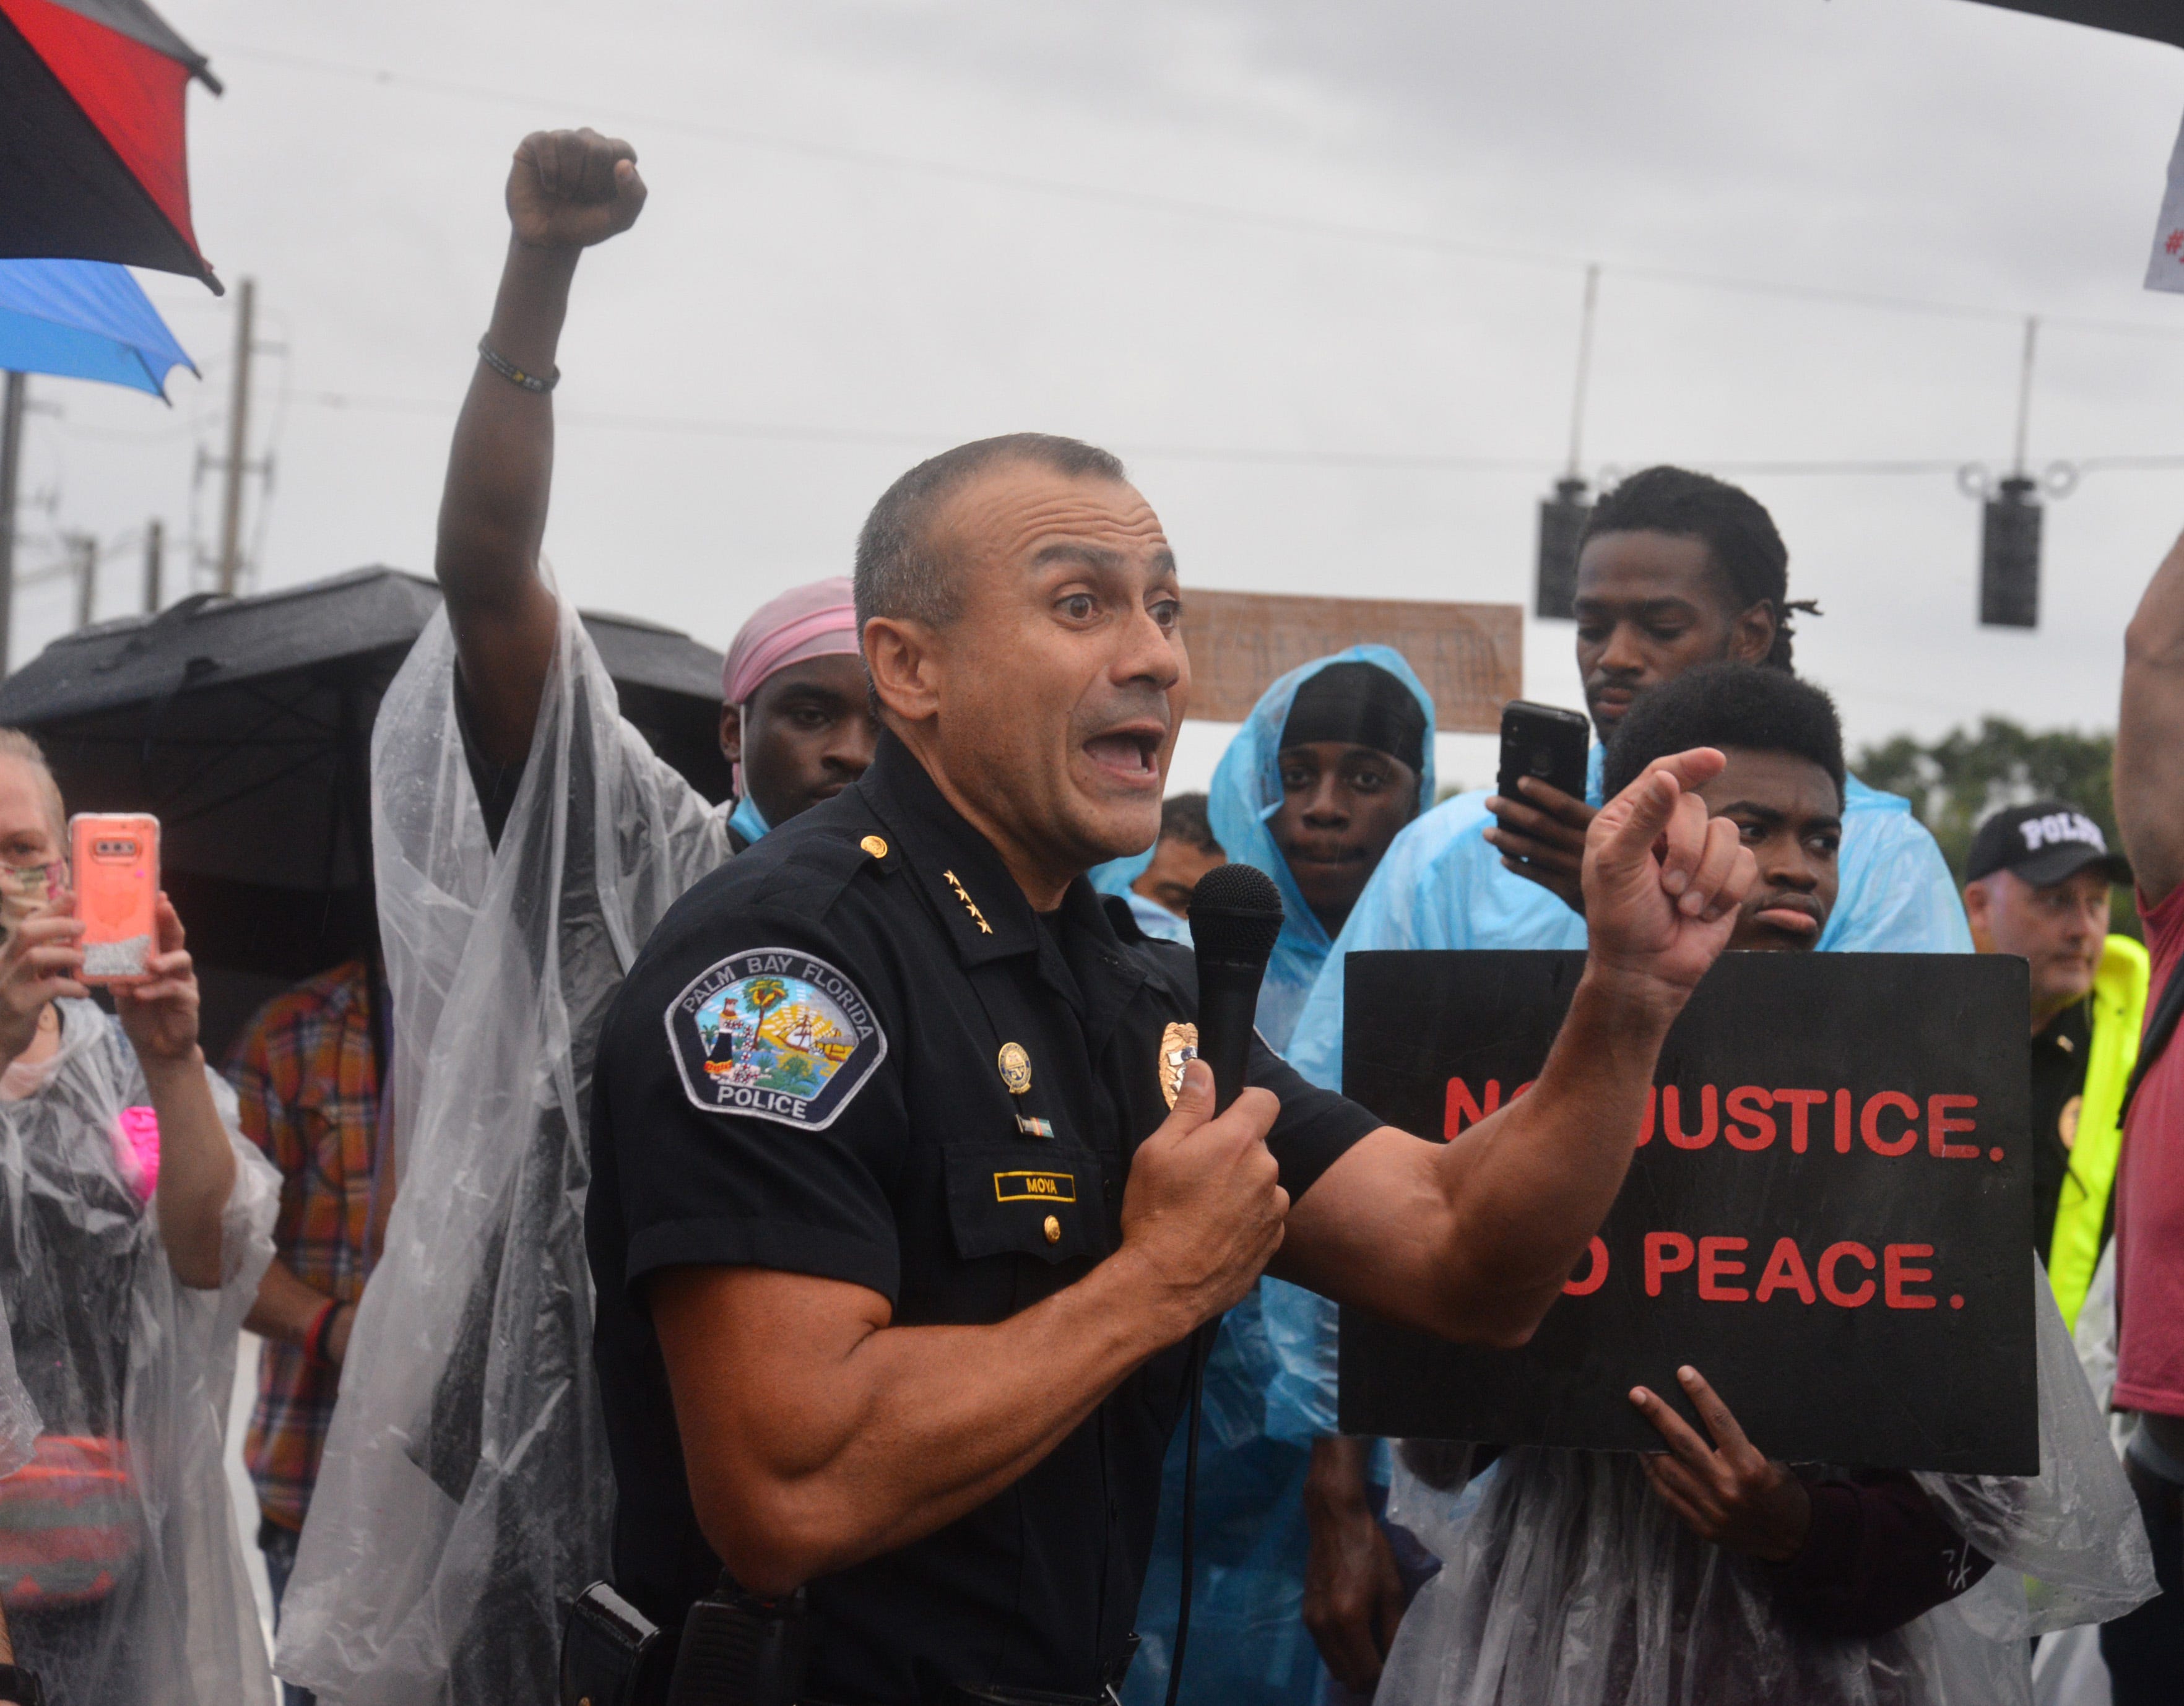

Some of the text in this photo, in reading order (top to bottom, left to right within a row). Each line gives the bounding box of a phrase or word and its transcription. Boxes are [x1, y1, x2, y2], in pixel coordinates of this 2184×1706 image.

[682, 955, 874, 1041] PALM BAY FLORIDA
[717, 1086, 808, 1119] POLICE
[1444, 1076, 2004, 1161] N JUSTICE.
[1026, 1177, 1058, 1195] MOYA
[1644, 1231, 1964, 1309] PEACE.
